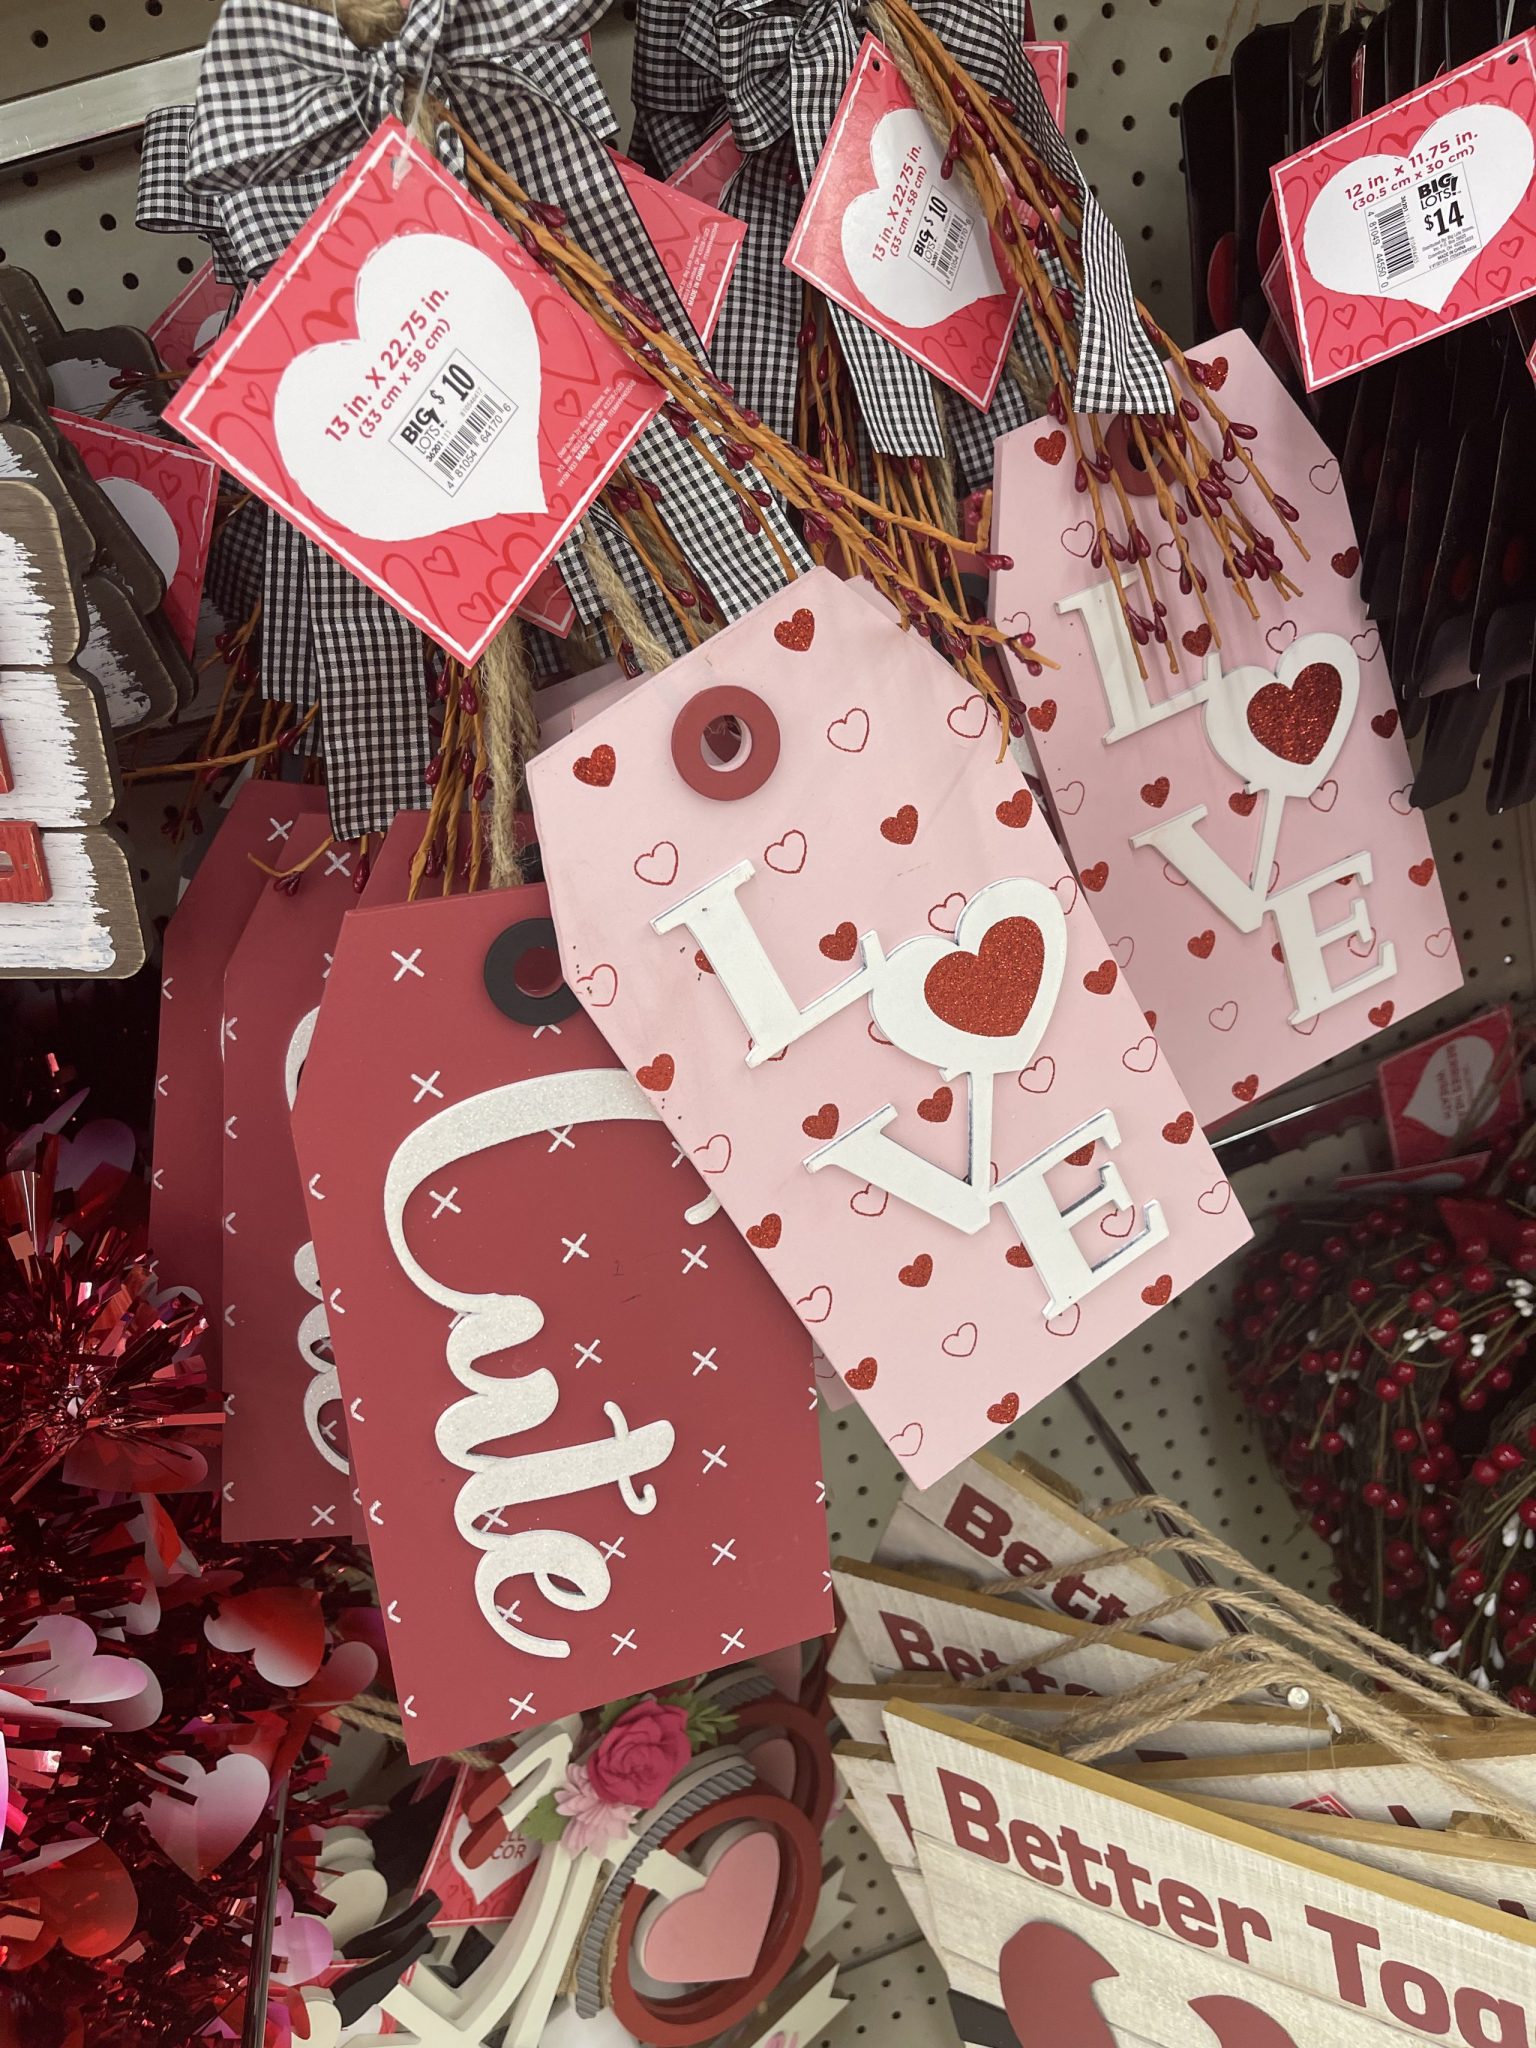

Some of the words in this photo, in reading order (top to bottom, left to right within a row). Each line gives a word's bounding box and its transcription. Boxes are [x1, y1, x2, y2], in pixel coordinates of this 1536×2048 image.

[905, 142, 922, 162] in.
[1343, 183, 1364, 200] 12
[1365, 170, 1390, 189] in.
[1407, 139, 1452, 168] 11.75
[1453, 126, 1479, 146] in.
[889, 162, 916, 207] 22.75
[911, 164, 928, 188] cm)
[1350, 186, 1388, 211] (30.5
[1389, 175, 1411, 191] cm
[1413, 170, 1423, 180] x
[1424, 159, 1444, 174] 30
[1446, 143, 1476, 164] cm)
[1414, 171, 1456, 199] BIG
[904, 207, 913, 215] x
[905, 189, 918, 205] 58
[924, 195, 951, 221] 10
[877, 223, 894, 243] in.
[896, 216, 910, 235] cm
[870, 244, 887, 262] 13
[887, 235, 904, 257] (33
[911, 229, 931, 257] BIG
[1369, 221, 1380, 245] 81049
[1375, 252, 1386, 277] 44550
[947, 254, 960, 276] 81054
[687, 288, 697, 306] MADE
[695, 262, 706, 281] CHINA
[420, 315, 453, 352] cm)
[323, 414, 352, 443] 13
[341, 385, 374, 418] in.
[363, 366, 388, 390] X
[376, 308, 431, 371] 22.75
[419, 281, 450, 313] in.
[404, 348, 428, 373] 58
[397, 371, 412, 386] x
[437, 361, 478, 401] 10
[377, 383, 402, 411] cm
[354, 407, 385, 440] (33
[399, 404, 435, 445] BIG
[424, 440, 444, 462] 36201
[446, 481, 454, 489] 4
[453, 449, 478, 478] 81054
[478, 414, 503, 443] 64170
[501, 402, 512, 412] 6
[574, 441, 591, 462] MADE
[586, 434, 596, 444] IN
[591, 417, 609, 438] CHINA
[937, 1767, 1272, 1964] Better
